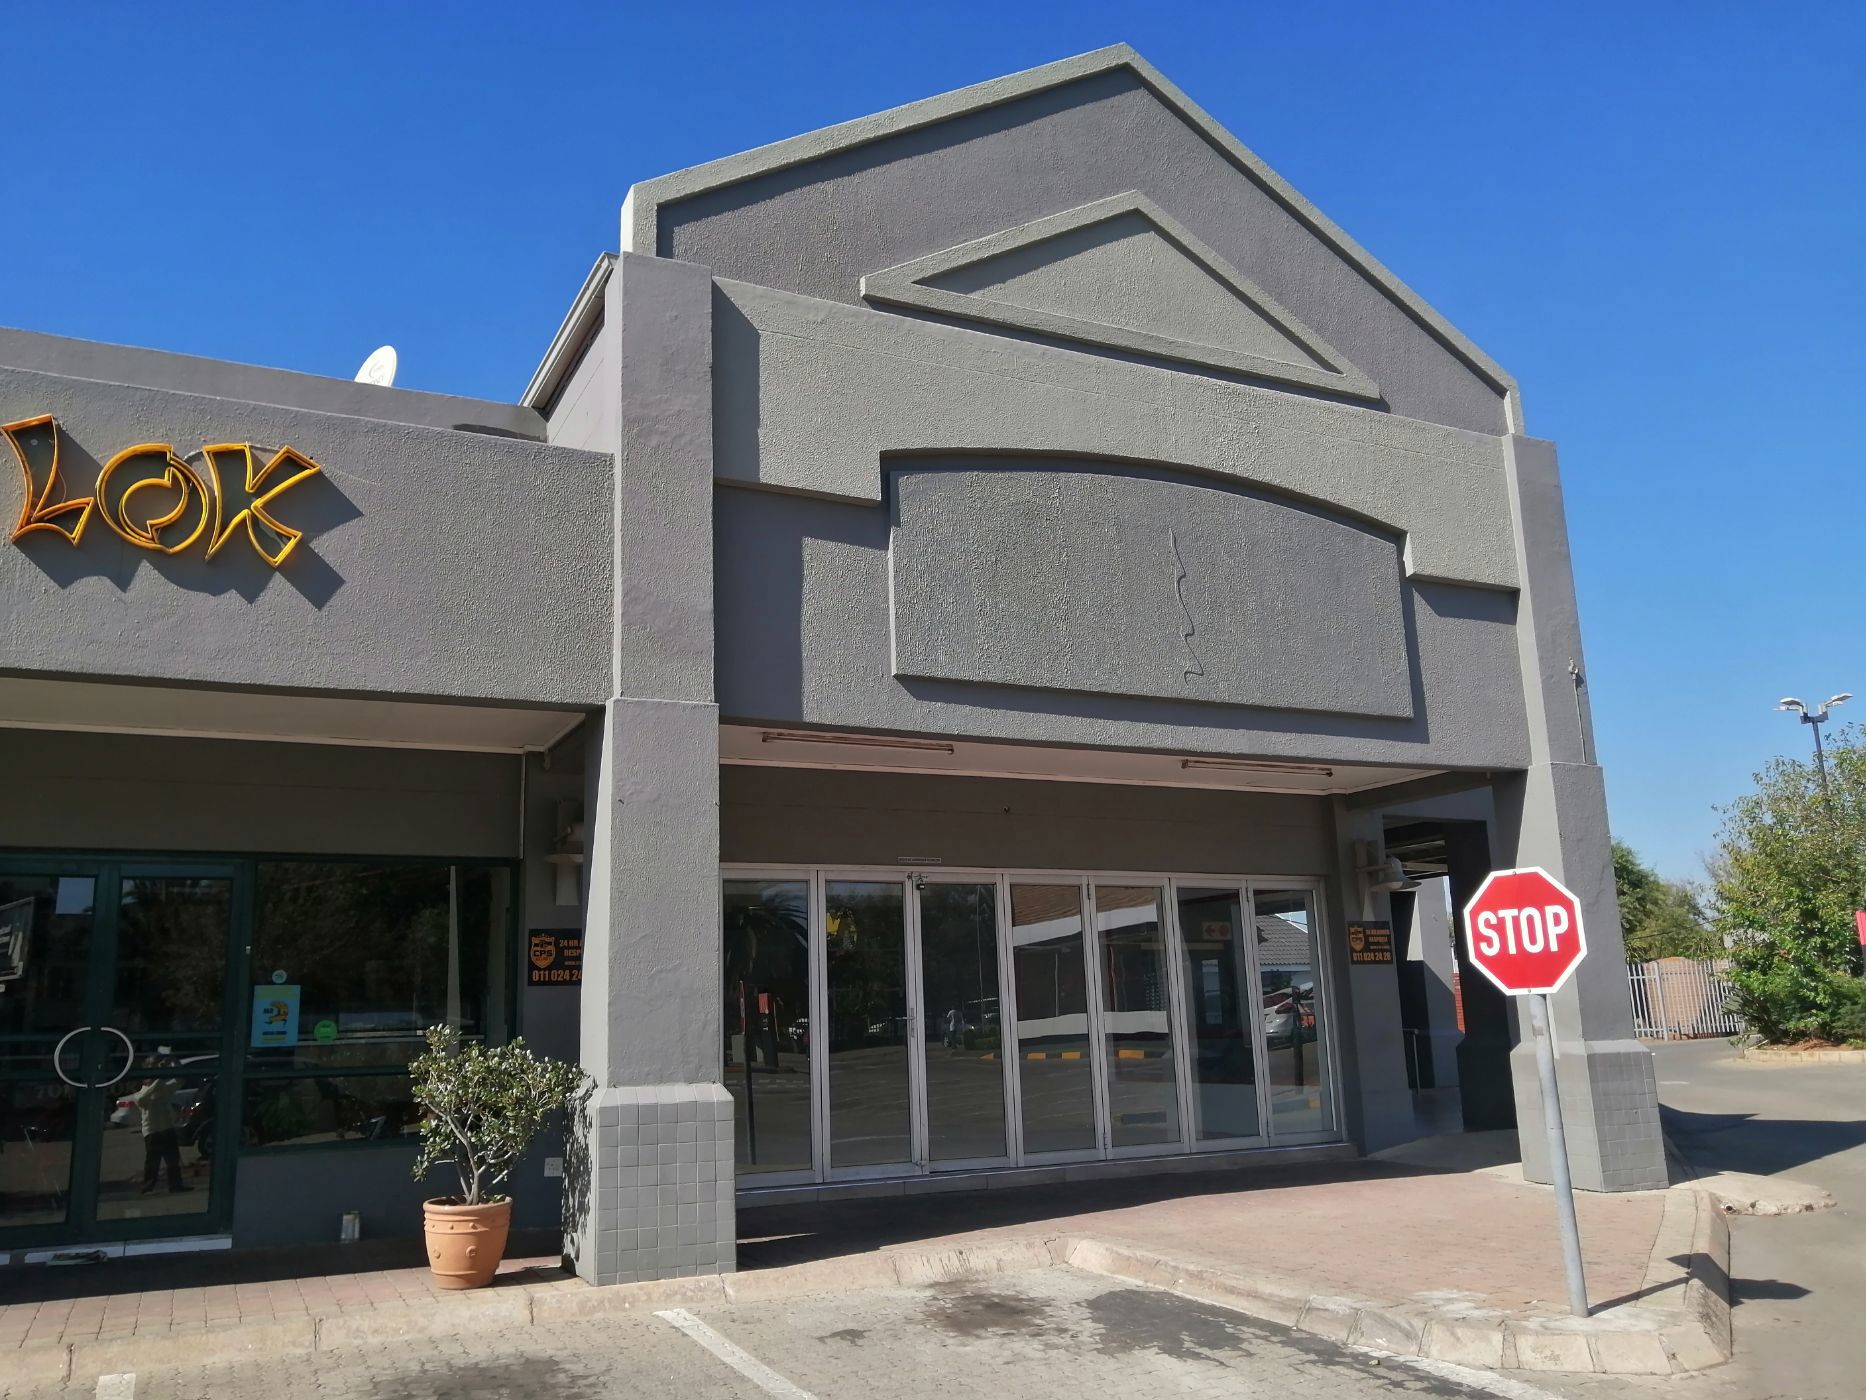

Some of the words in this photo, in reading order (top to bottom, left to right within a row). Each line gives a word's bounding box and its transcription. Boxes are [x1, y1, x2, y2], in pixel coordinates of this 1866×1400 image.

[1, 413, 320, 568] LOK
[1477, 905, 1568, 956] STOP
[532, 970, 549, 981] 011
[551, 970, 570, 981] 024
